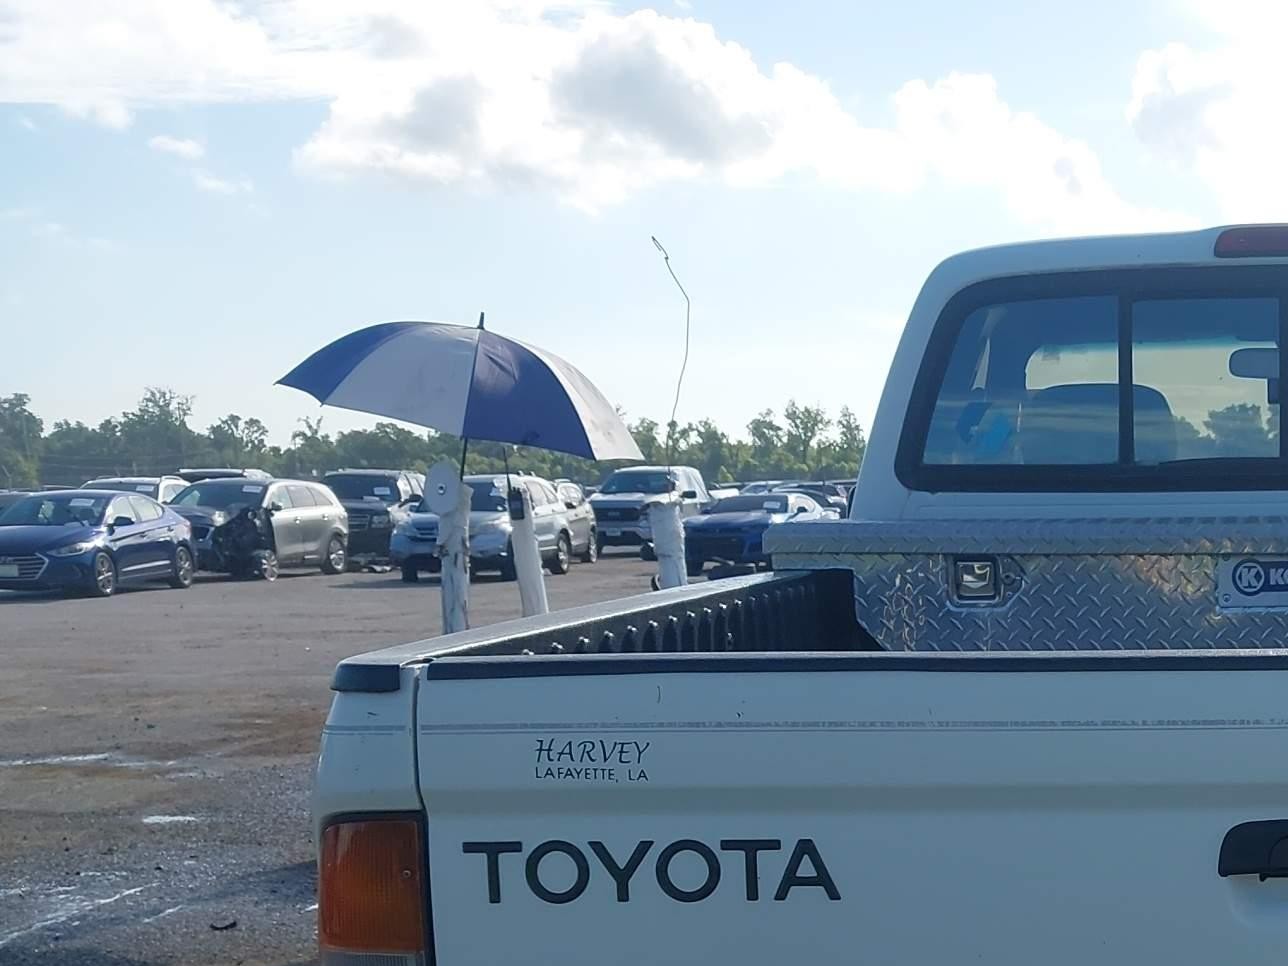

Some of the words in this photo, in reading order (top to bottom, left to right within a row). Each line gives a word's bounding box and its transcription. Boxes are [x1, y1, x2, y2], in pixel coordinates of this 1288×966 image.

[535, 738, 650, 764] HARVEY
[535, 767, 619, 783] LAFAYETTE,
[628, 768, 649, 782] LA
[462, 838, 842, 904] TOYOTA
